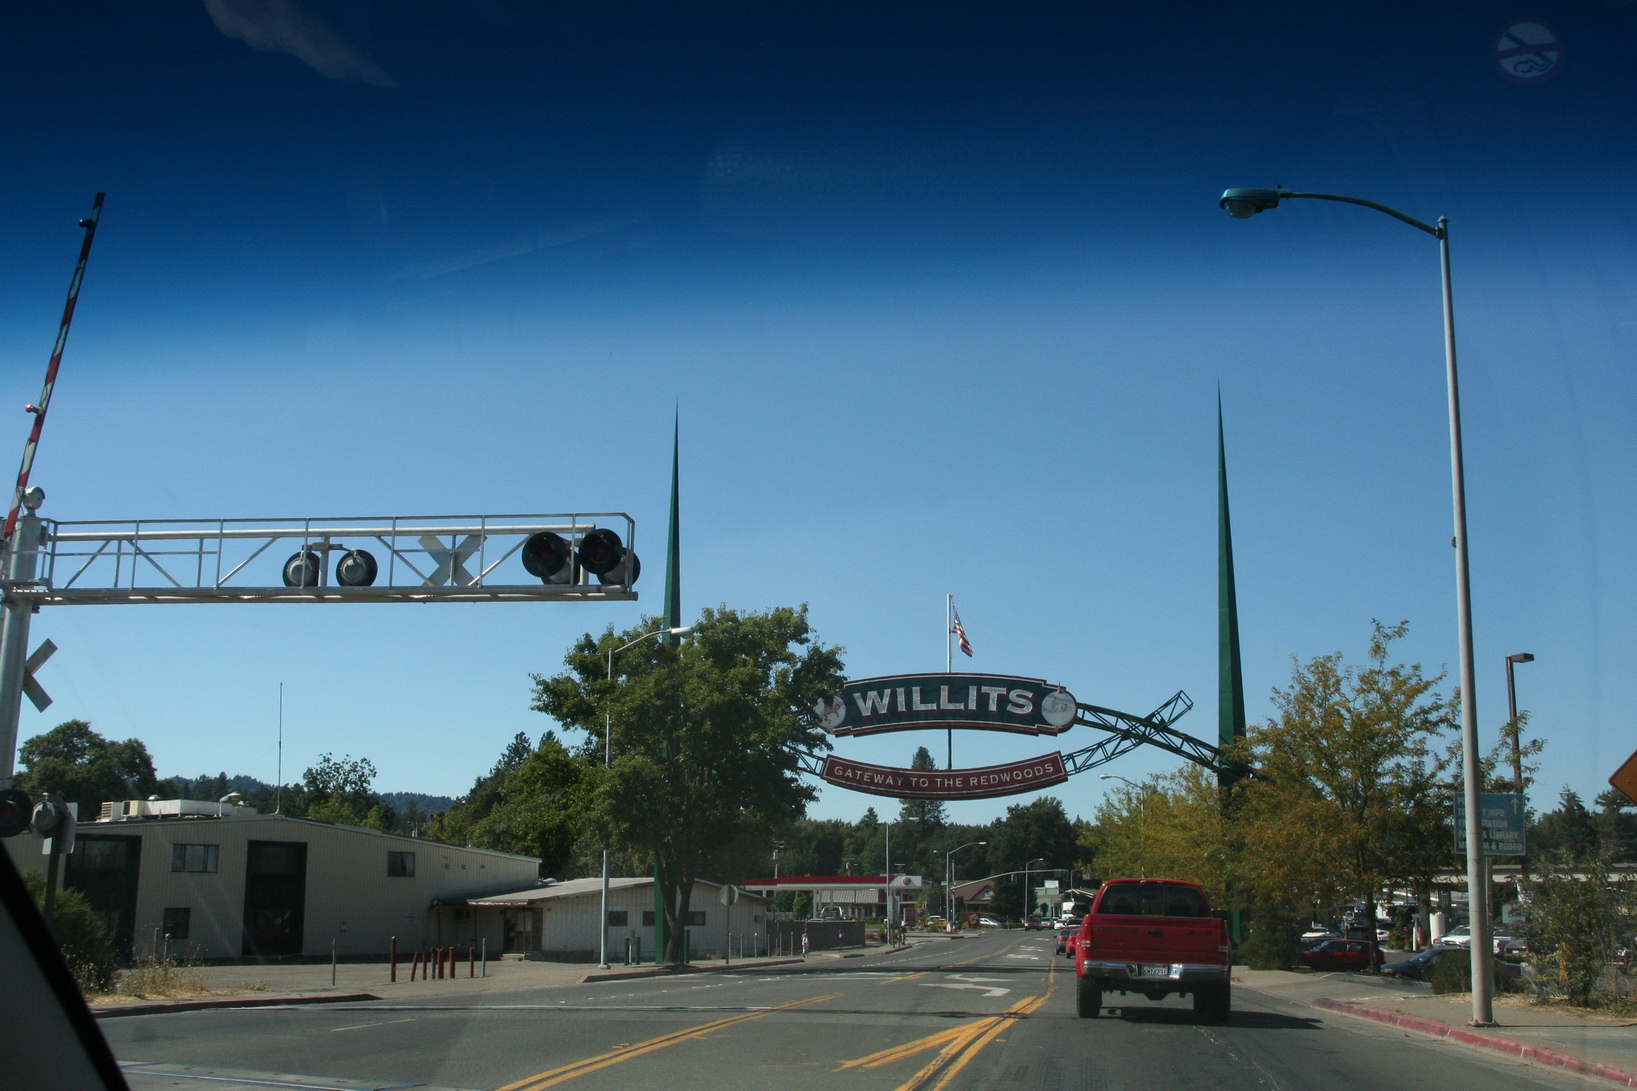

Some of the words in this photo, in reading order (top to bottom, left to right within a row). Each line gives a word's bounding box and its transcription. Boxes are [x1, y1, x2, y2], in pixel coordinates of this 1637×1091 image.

[853, 686, 1034, 716] WILLITS
[834, 766, 904, 786] GATEWAY
[910, 777, 929, 787] TO
[935, 778, 963, 788] THE
[970, 763, 1054, 786] REDWOODS
[1488, 808, 1504, 817] INFO
[1490, 831, 1518, 839] LIBRARY
[1498, 842, 1522, 850] RODEO
